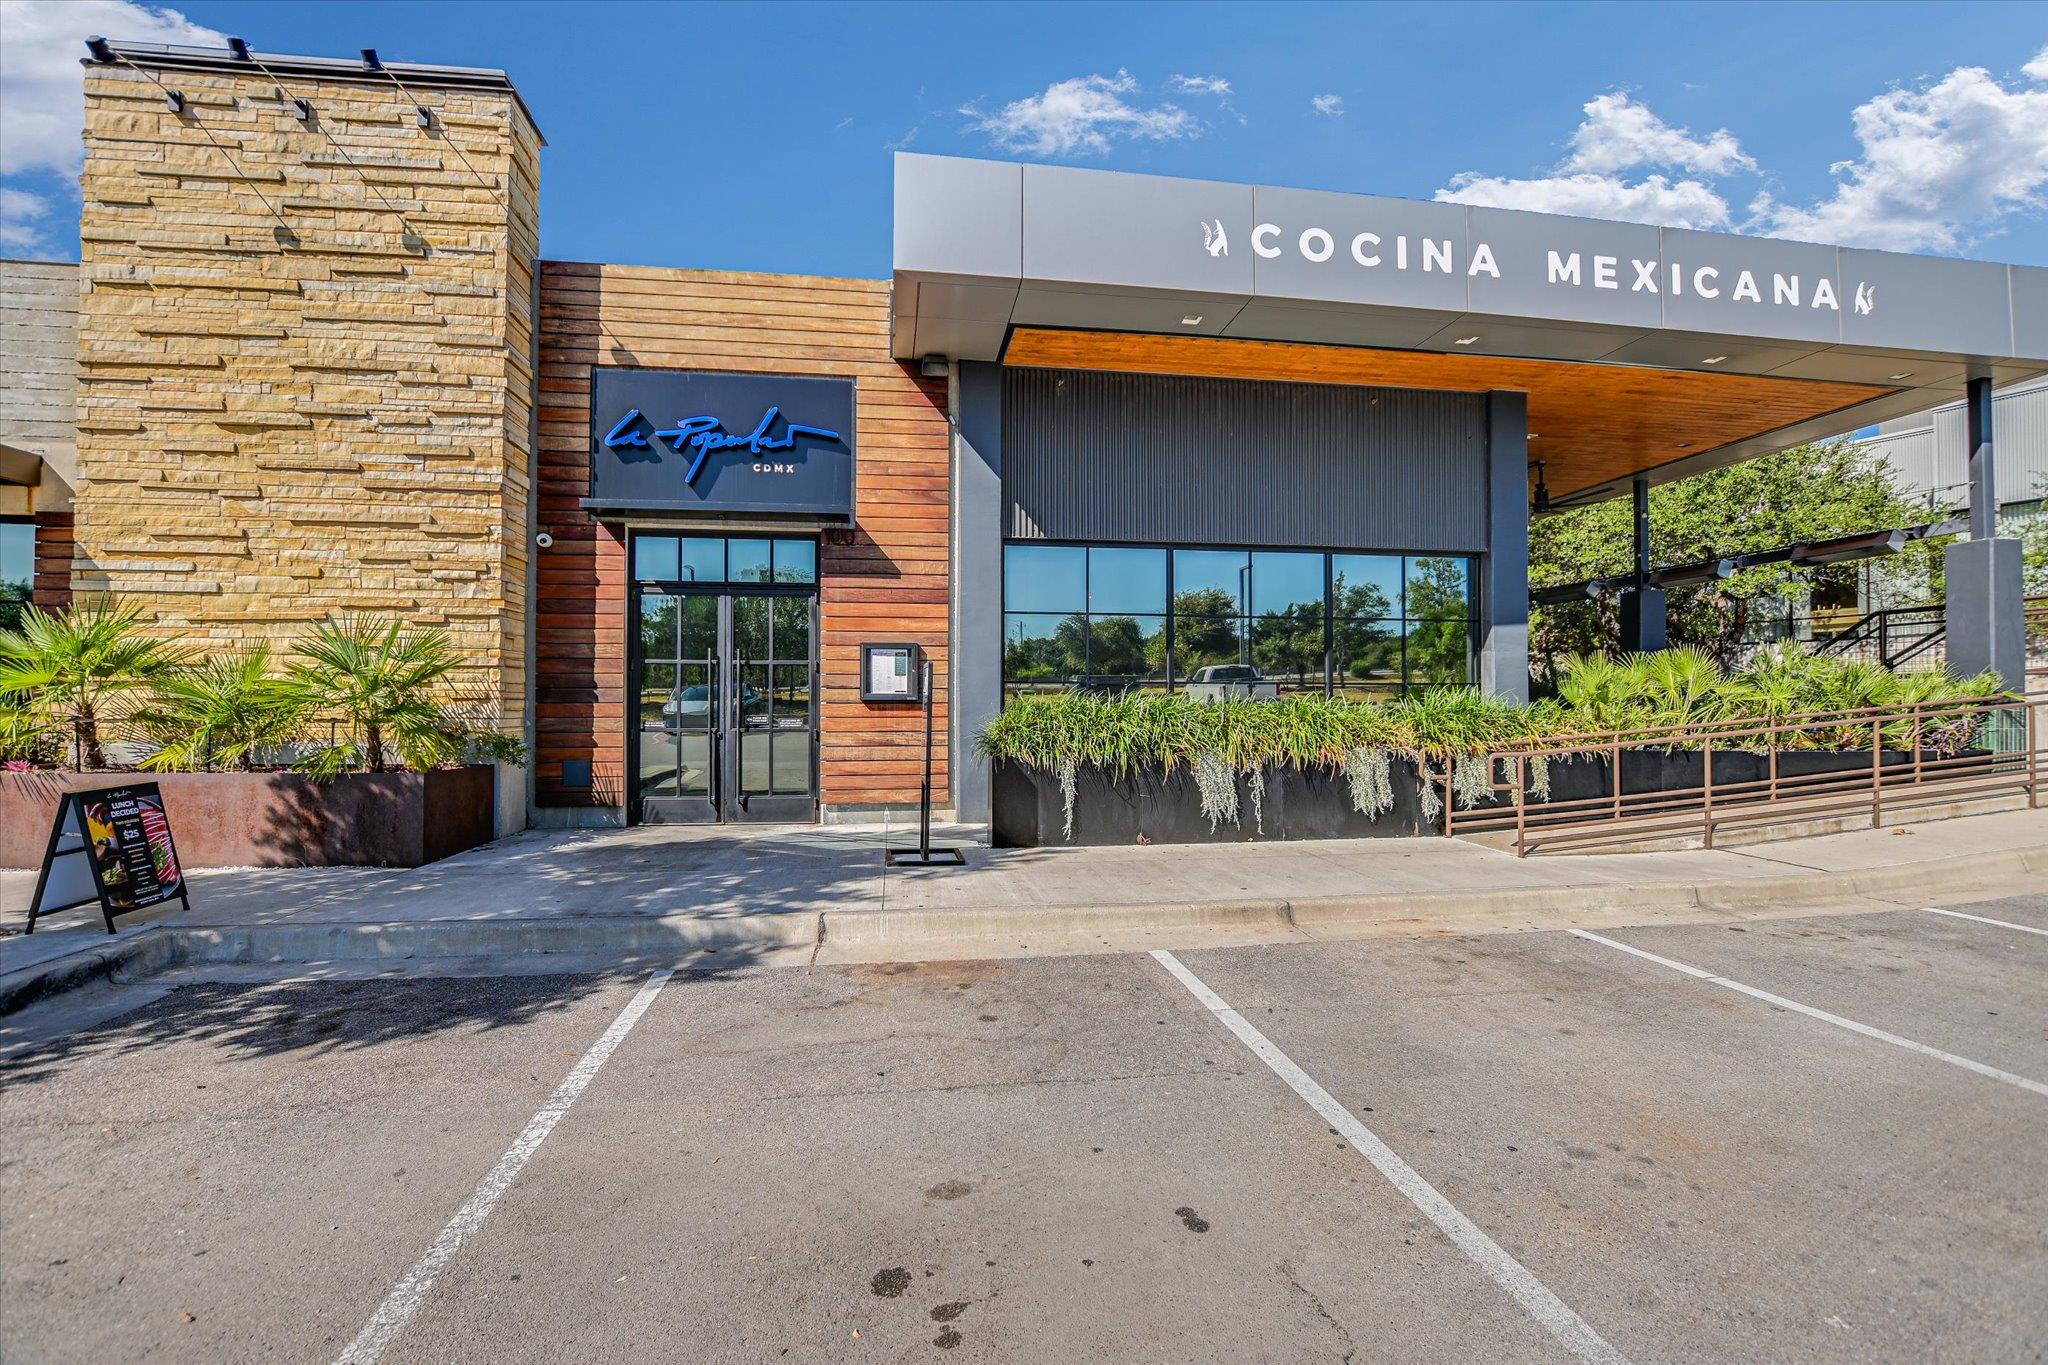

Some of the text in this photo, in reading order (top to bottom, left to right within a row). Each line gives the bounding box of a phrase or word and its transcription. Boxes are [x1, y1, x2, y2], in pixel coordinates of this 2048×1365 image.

[1251, 222, 1839, 311] COCINA MEXICANA
[603, 405, 840, 484] La Popular
[753, 463, 794, 474] CDMX
[111, 800, 135, 810] LUNCH
[110, 807, 140, 818] DECIDED
[123, 829, 140, 841] $25
